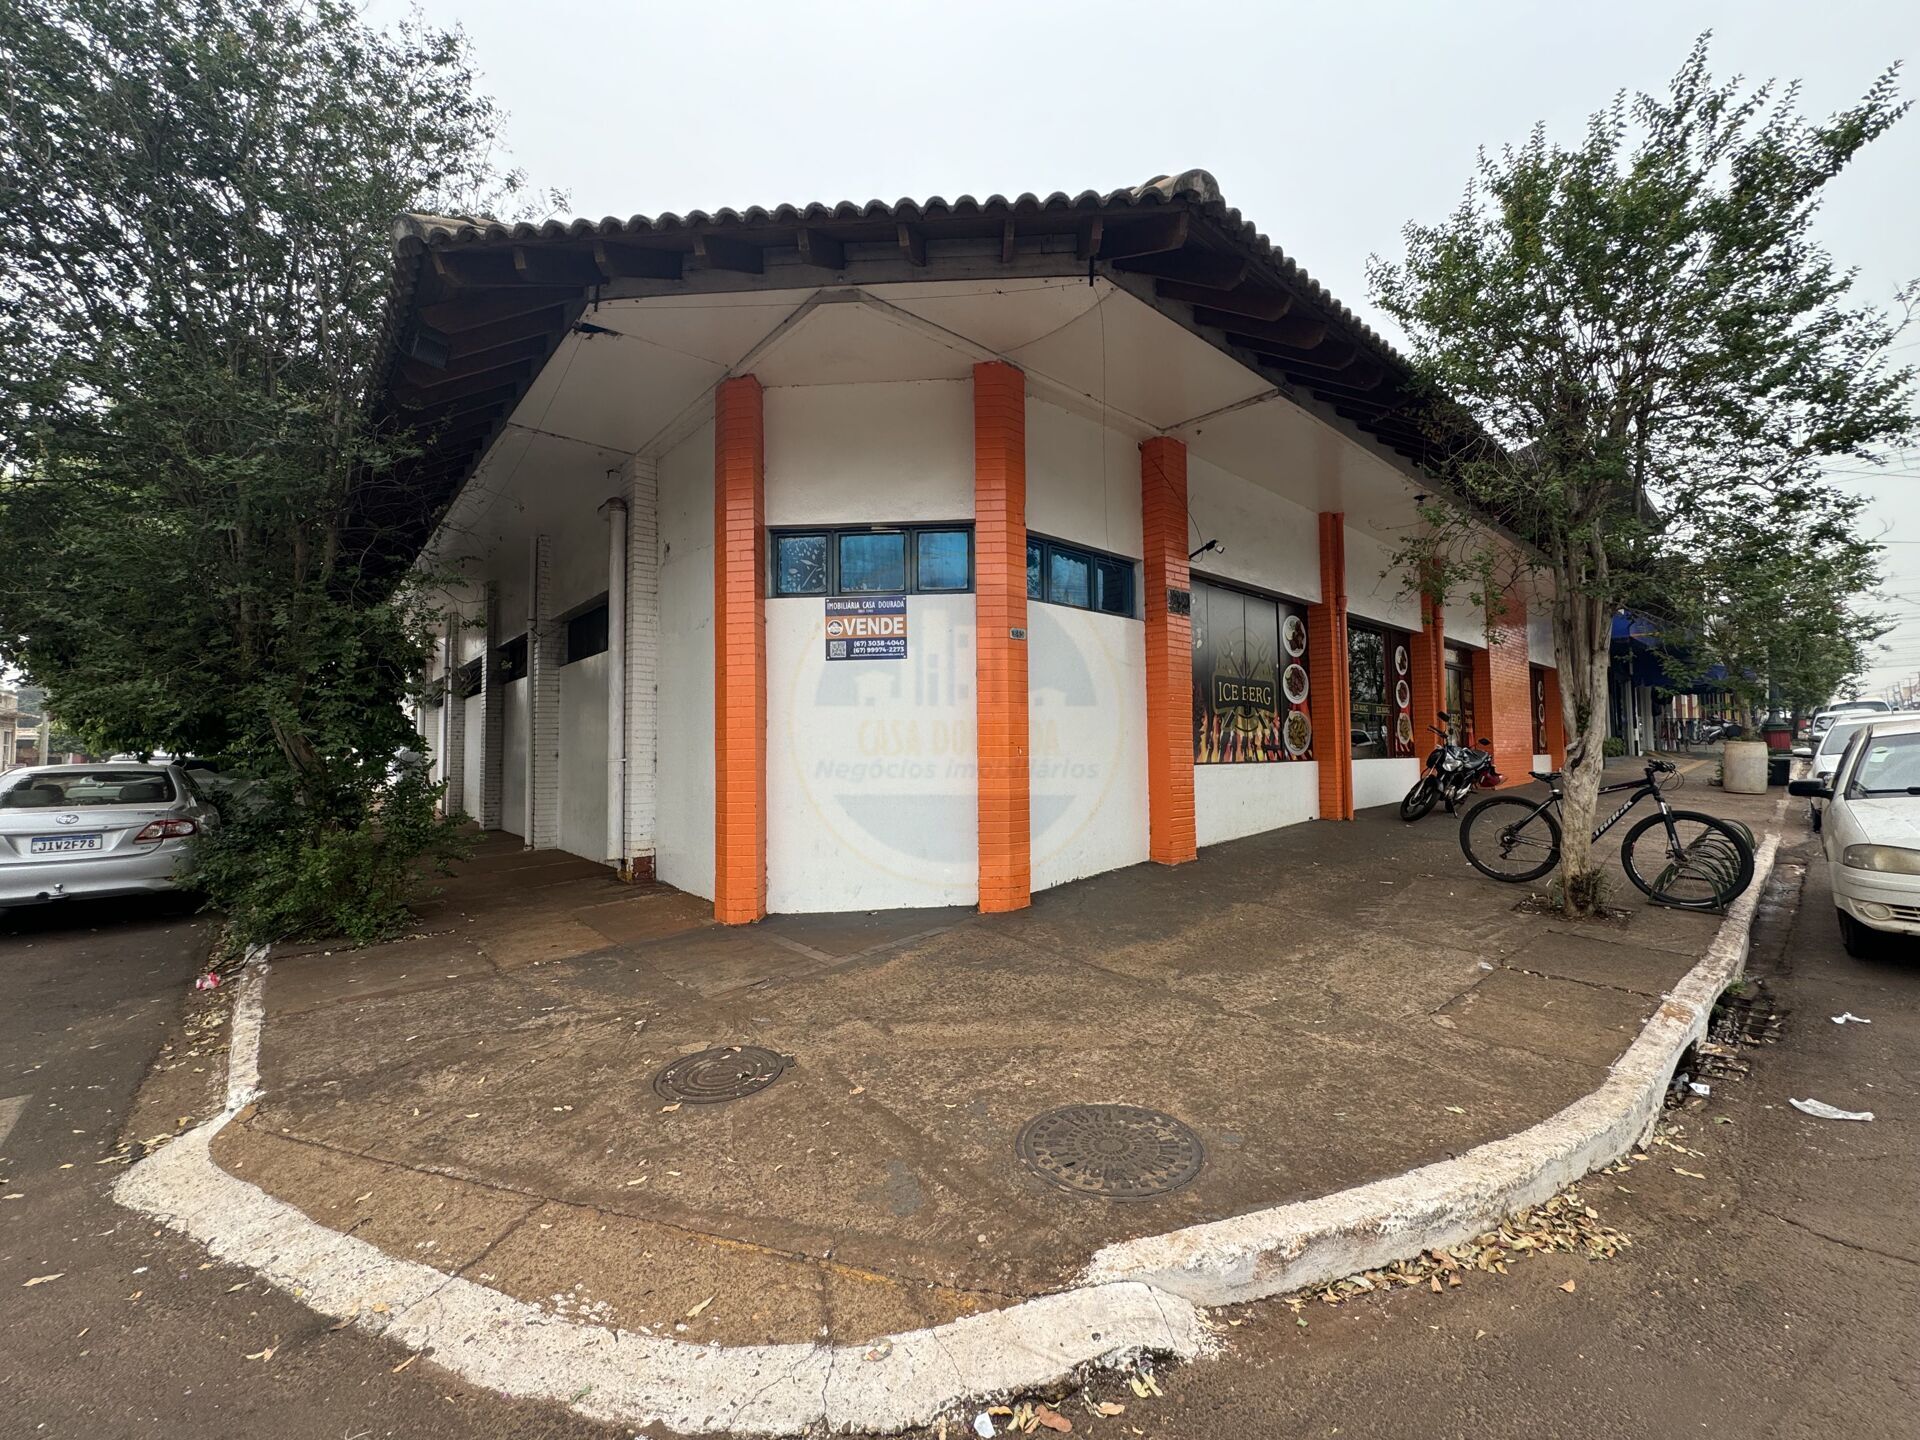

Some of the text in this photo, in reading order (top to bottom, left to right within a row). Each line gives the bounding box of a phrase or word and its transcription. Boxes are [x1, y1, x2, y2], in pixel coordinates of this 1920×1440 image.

[827, 601, 904, 610] IMOBILIÁRIA CASA DOURADA
[843, 617, 904, 635] VENDE
[1218, 681, 1271, 705] ICE BERG
[38, 839, 95, 851] JIW2F78
